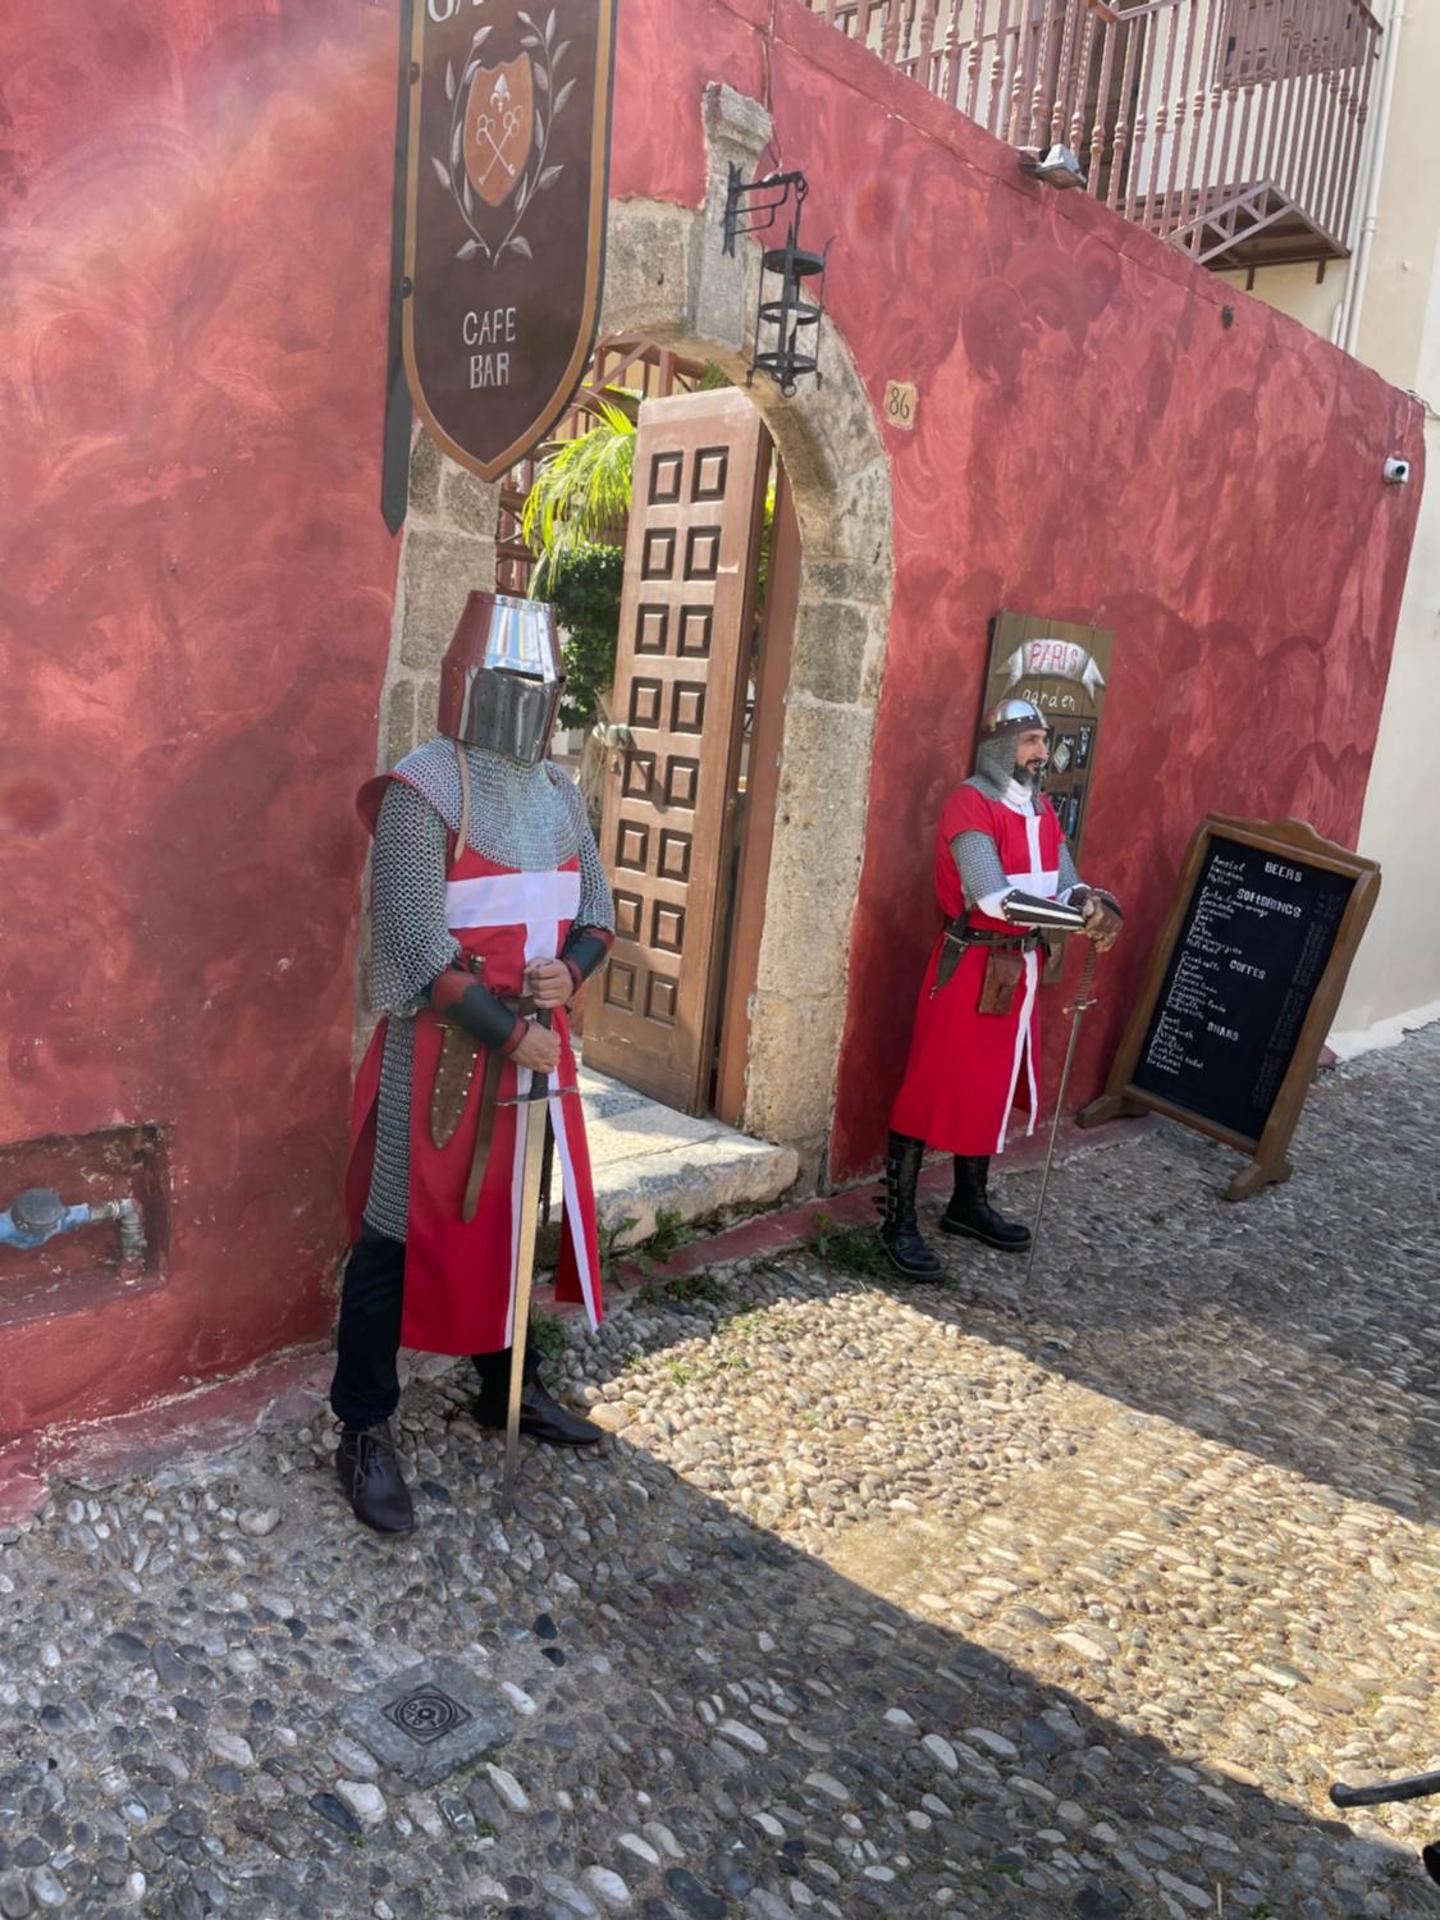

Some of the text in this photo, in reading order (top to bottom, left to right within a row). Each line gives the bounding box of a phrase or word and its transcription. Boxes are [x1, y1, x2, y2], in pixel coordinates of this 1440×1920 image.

[463, 307, 516, 345] CAFE
[470, 352, 510, 389] BAR
[890, 387, 910, 418] 86
[1028, 643, 1079, 672] PARIS
[1264, 861, 1302, 882] BEERS
